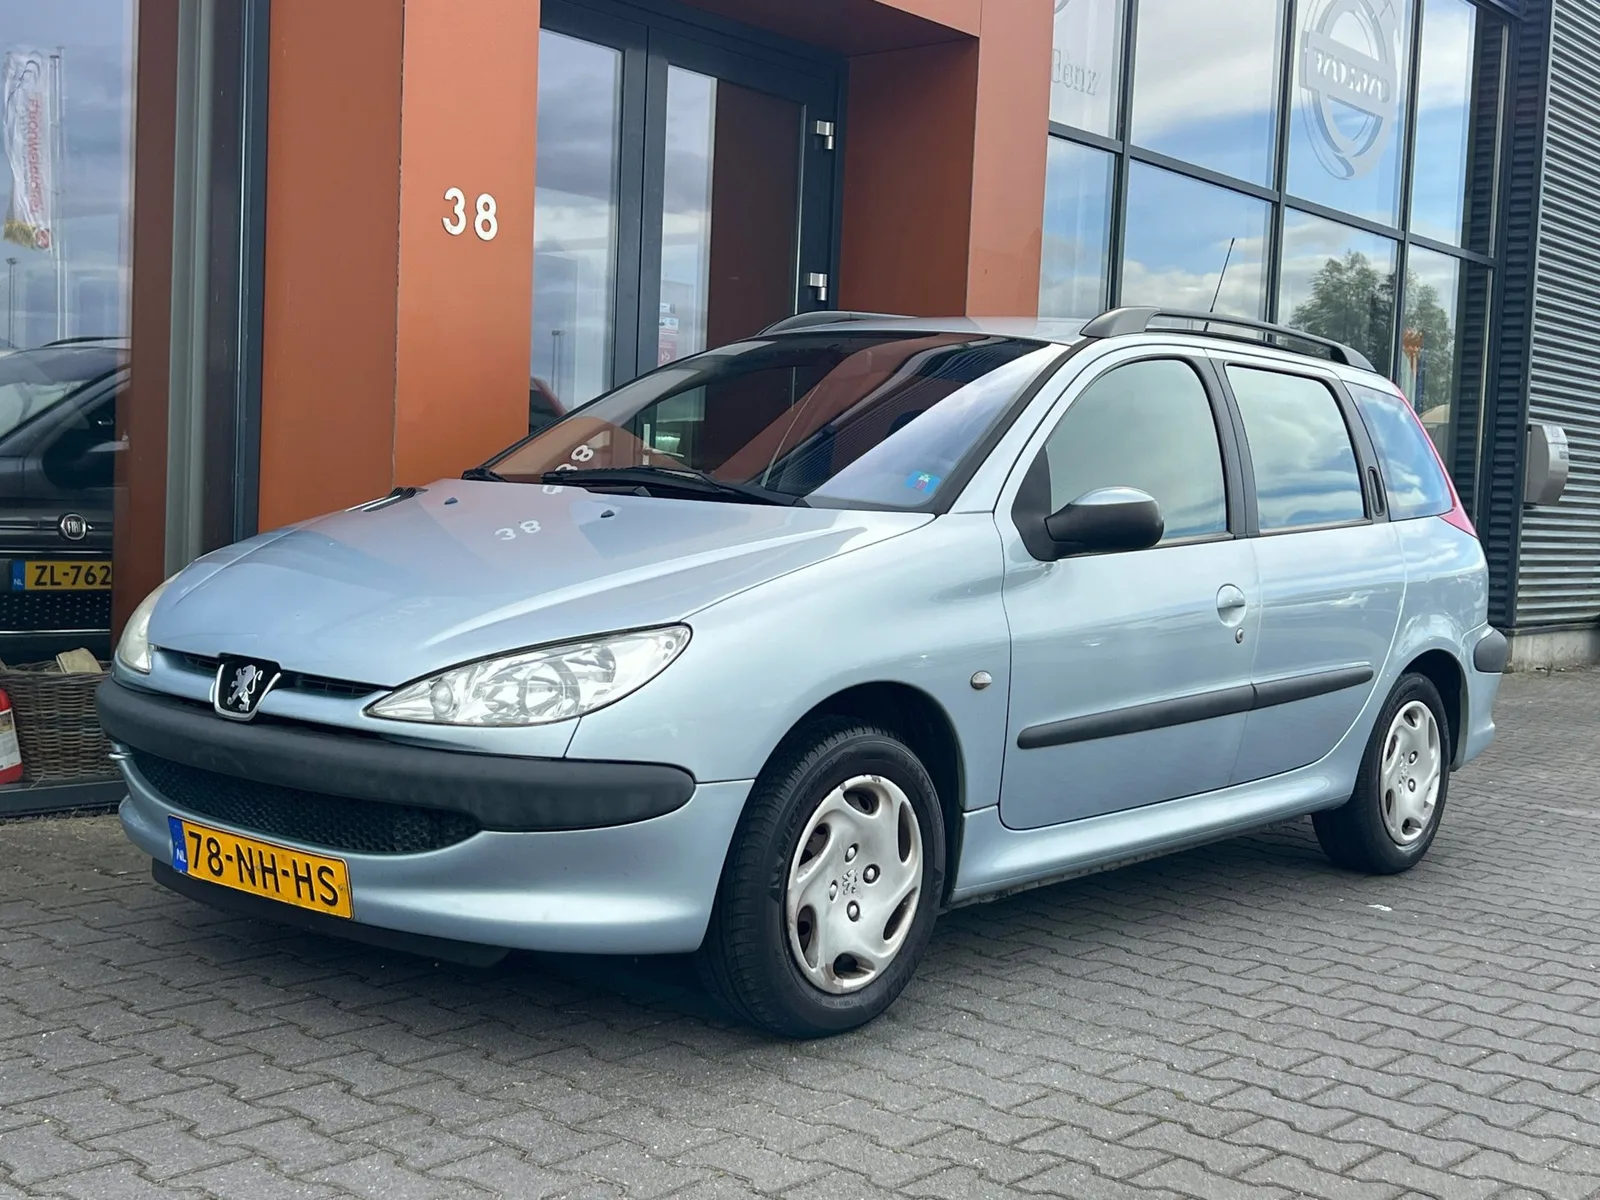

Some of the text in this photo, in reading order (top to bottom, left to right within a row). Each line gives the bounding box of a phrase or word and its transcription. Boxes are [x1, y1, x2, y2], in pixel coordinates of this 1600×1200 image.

[1313, 46, 1390, 103] VOLVO
[441, 186, 498, 241] 38
[494, 519, 541, 541] 38
[34, 565, 111, 587] ZL-762
[176, 848, 187, 862] NL
[188, 830, 339, 906] 78-NH-HS
